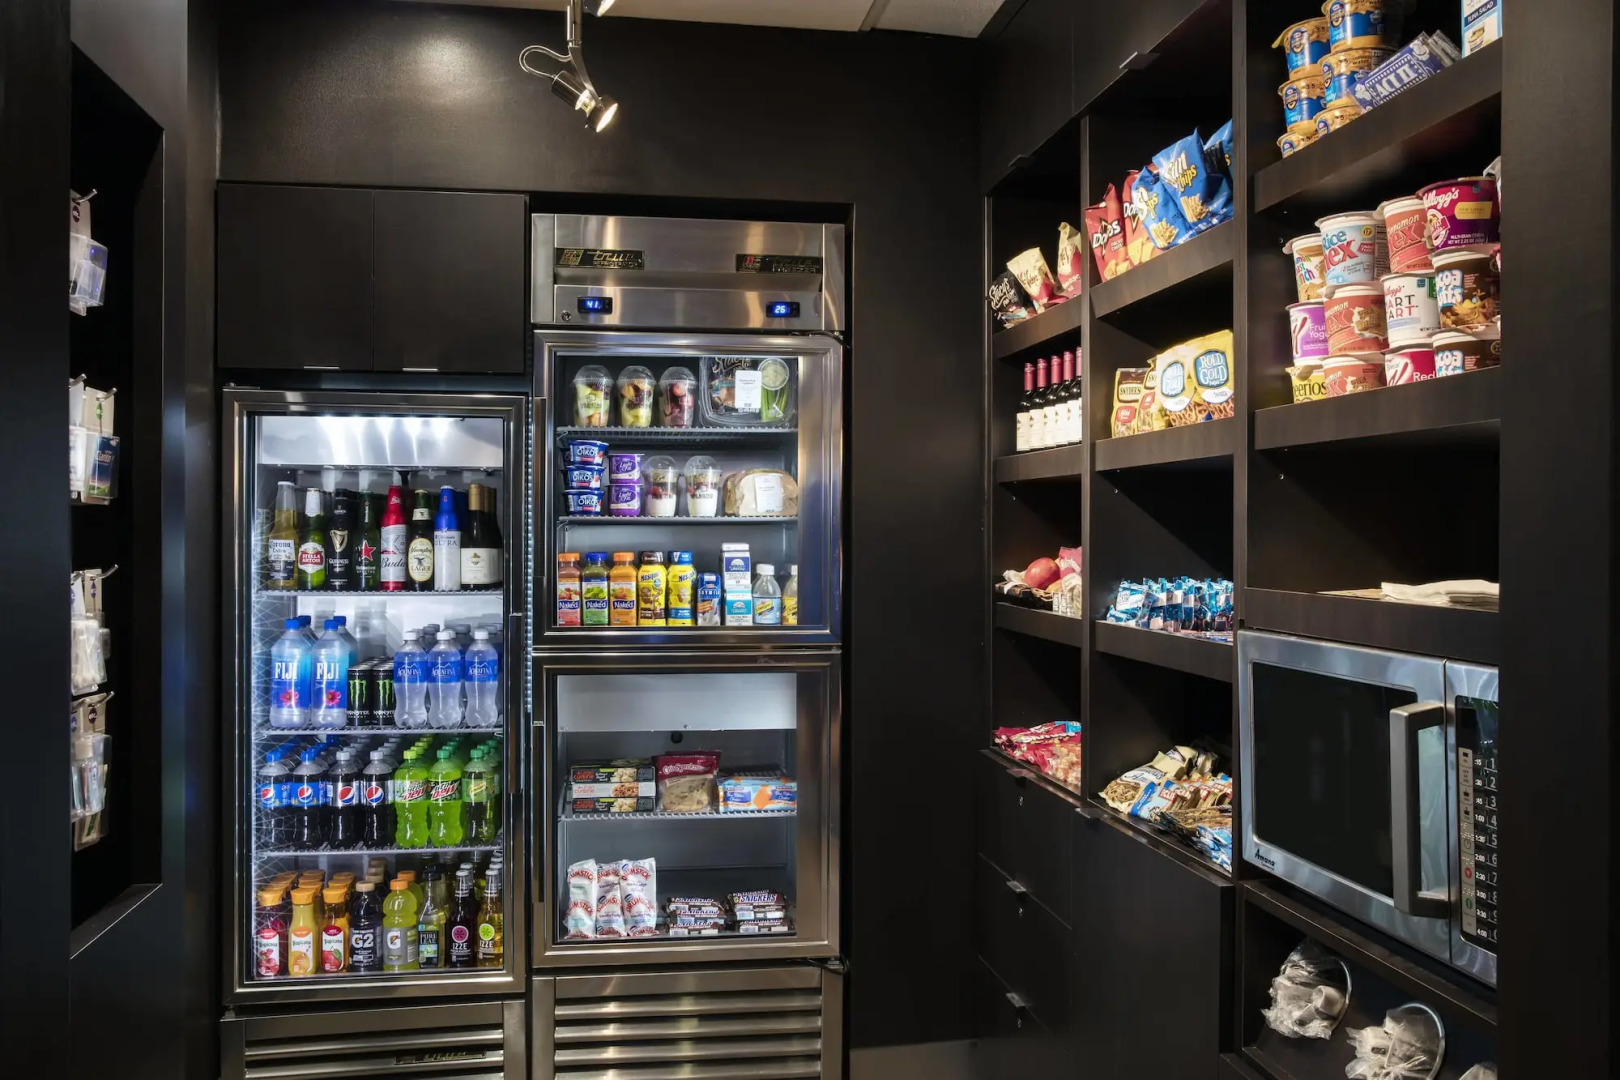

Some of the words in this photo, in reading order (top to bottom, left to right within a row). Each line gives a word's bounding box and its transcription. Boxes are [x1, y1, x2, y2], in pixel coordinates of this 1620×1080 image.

[1374, 73, 1400, 98] ACT
[1396, 63, 1418, 81] II
[774, 305, 786, 314] 26
[1199, 352, 1224, 368] ROLD
[1200, 365, 1228, 386] GOLD
[274, 661, 298, 680] FIJI
[316, 661, 340, 680] FIJI
[1475, 813, 1485, 823] 1:00
[1475, 834, 1486, 843] 1:30
[1475, 853, 1486, 862] 2:00
[1475, 871, 1486, 881] 2:30
[739, 893, 778, 903] SNICKERS
[1476, 889, 1487, 899] 3:00
[1476, 908, 1487, 918] 3:30
[351, 933, 374, 949] G2
[479, 940, 494, 948] IZZE
